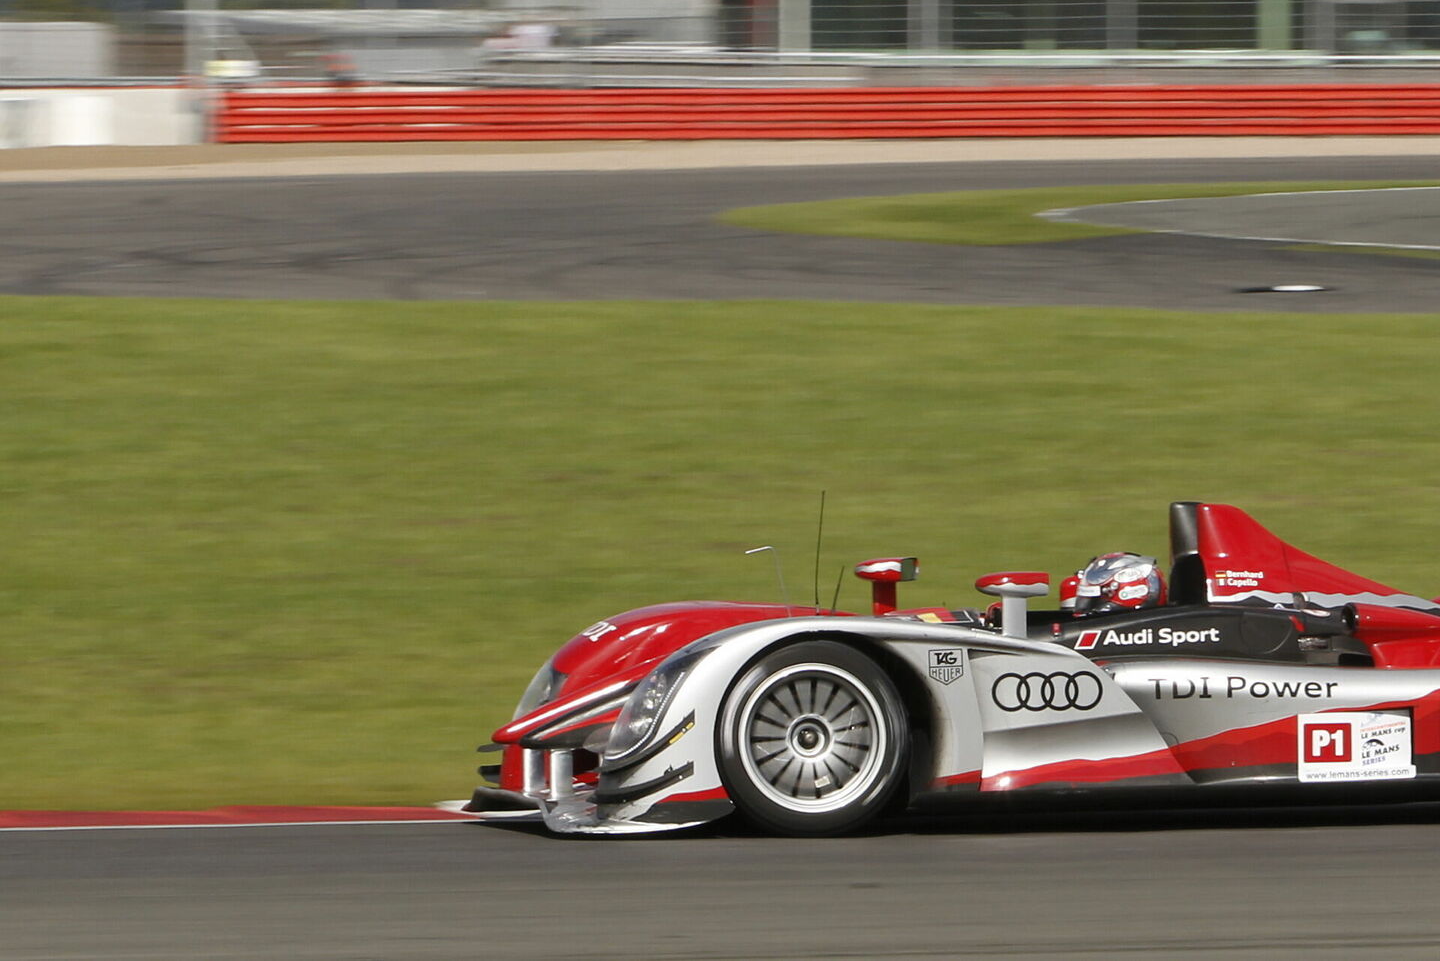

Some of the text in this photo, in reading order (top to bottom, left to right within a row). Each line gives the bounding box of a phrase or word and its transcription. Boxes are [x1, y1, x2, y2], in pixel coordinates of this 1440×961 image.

[1103, 628, 1220, 647] Audi Sport
[934, 652, 957, 665] TAG
[932, 668, 961, 682] HEUER
[1148, 676, 1338, 700] TDI Power
[1371, 728, 1392, 737] MANS
[1312, 729, 1344, 757] P1
[1361, 744, 1400, 759] LE MANS
[1306, 768, 1410, 779] www.lemans-series.com
